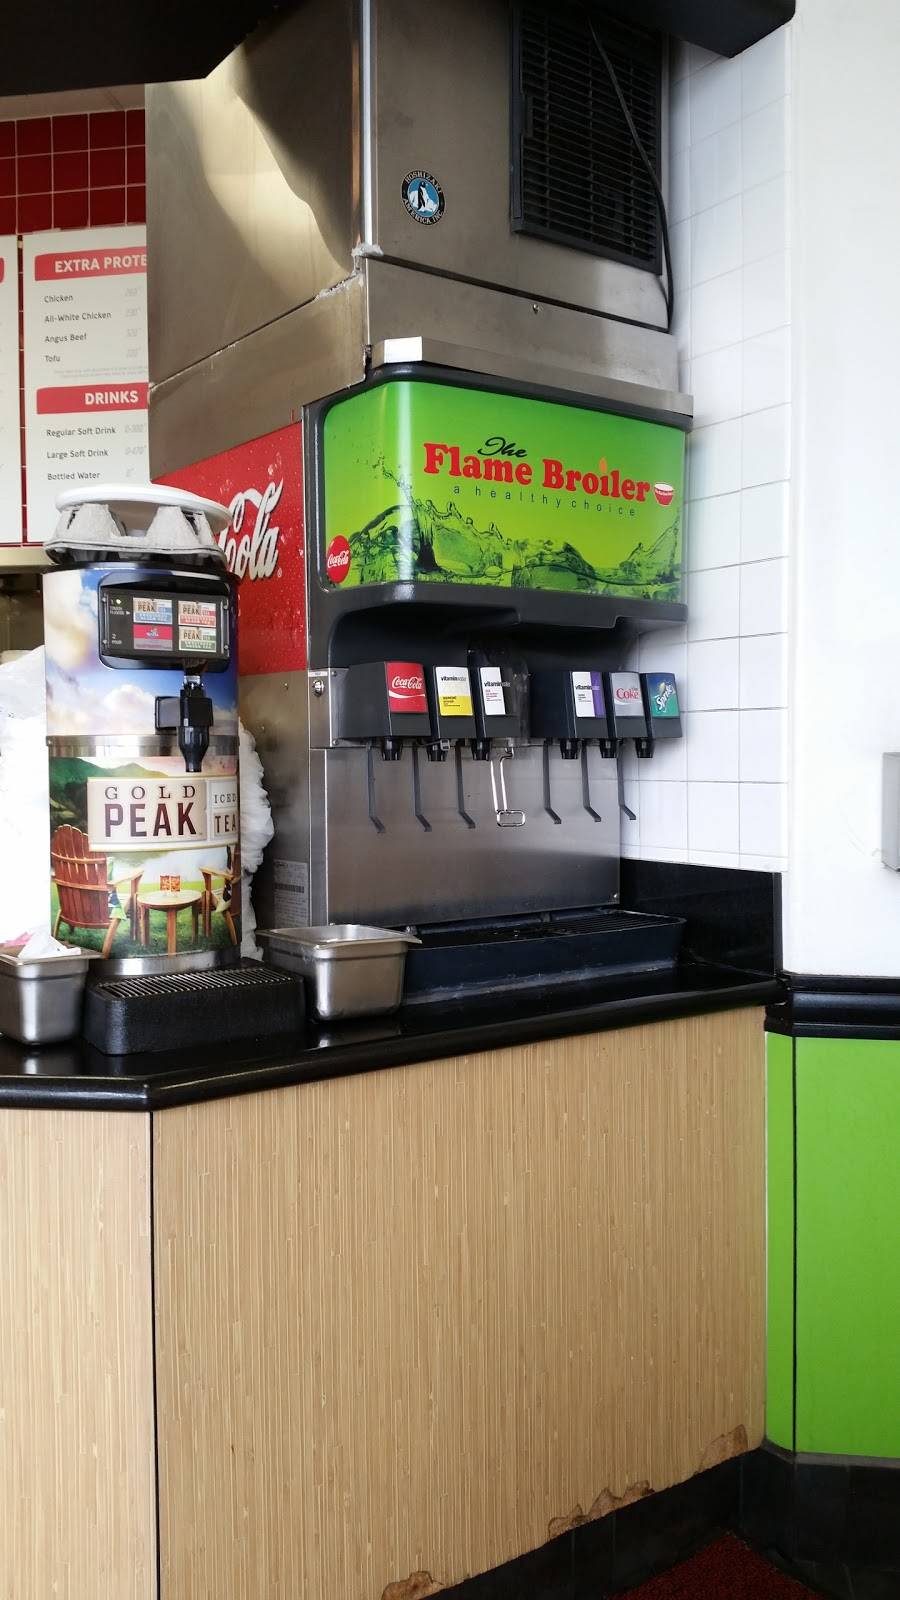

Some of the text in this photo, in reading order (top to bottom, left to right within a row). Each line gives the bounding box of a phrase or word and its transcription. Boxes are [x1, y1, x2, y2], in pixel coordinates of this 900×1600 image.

[55, 257, 100, 273] EXTRA
[43, 294, 74, 303] Chicken
[44, 311, 112, 323] All-White Chicken
[45, 333, 87, 344] Angus Beef
[45, 354, 61, 362] Tofu
[84, 390, 139, 405] DRINKS
[46, 428, 75, 438] Regular
[77, 427, 93, 436] Soft
[95, 426, 117, 435] Drink
[477, 436, 529, 458] The
[47, 449, 109, 459] Large Soft Drink
[47, 471, 100, 480] Bottled Water
[423, 442, 651, 502] Flame Broiler
[183, 606, 200, 615] PEAK
[183, 631, 200, 640] PEAK
[616, 687, 639, 700] Coke
[653, 684, 677, 713] Sprite
[104, 785, 196, 800] GOLD
[214, 792, 237, 804] ICED
[104, 802, 197, 838] PEAK
[214, 814, 237, 833] TEA
